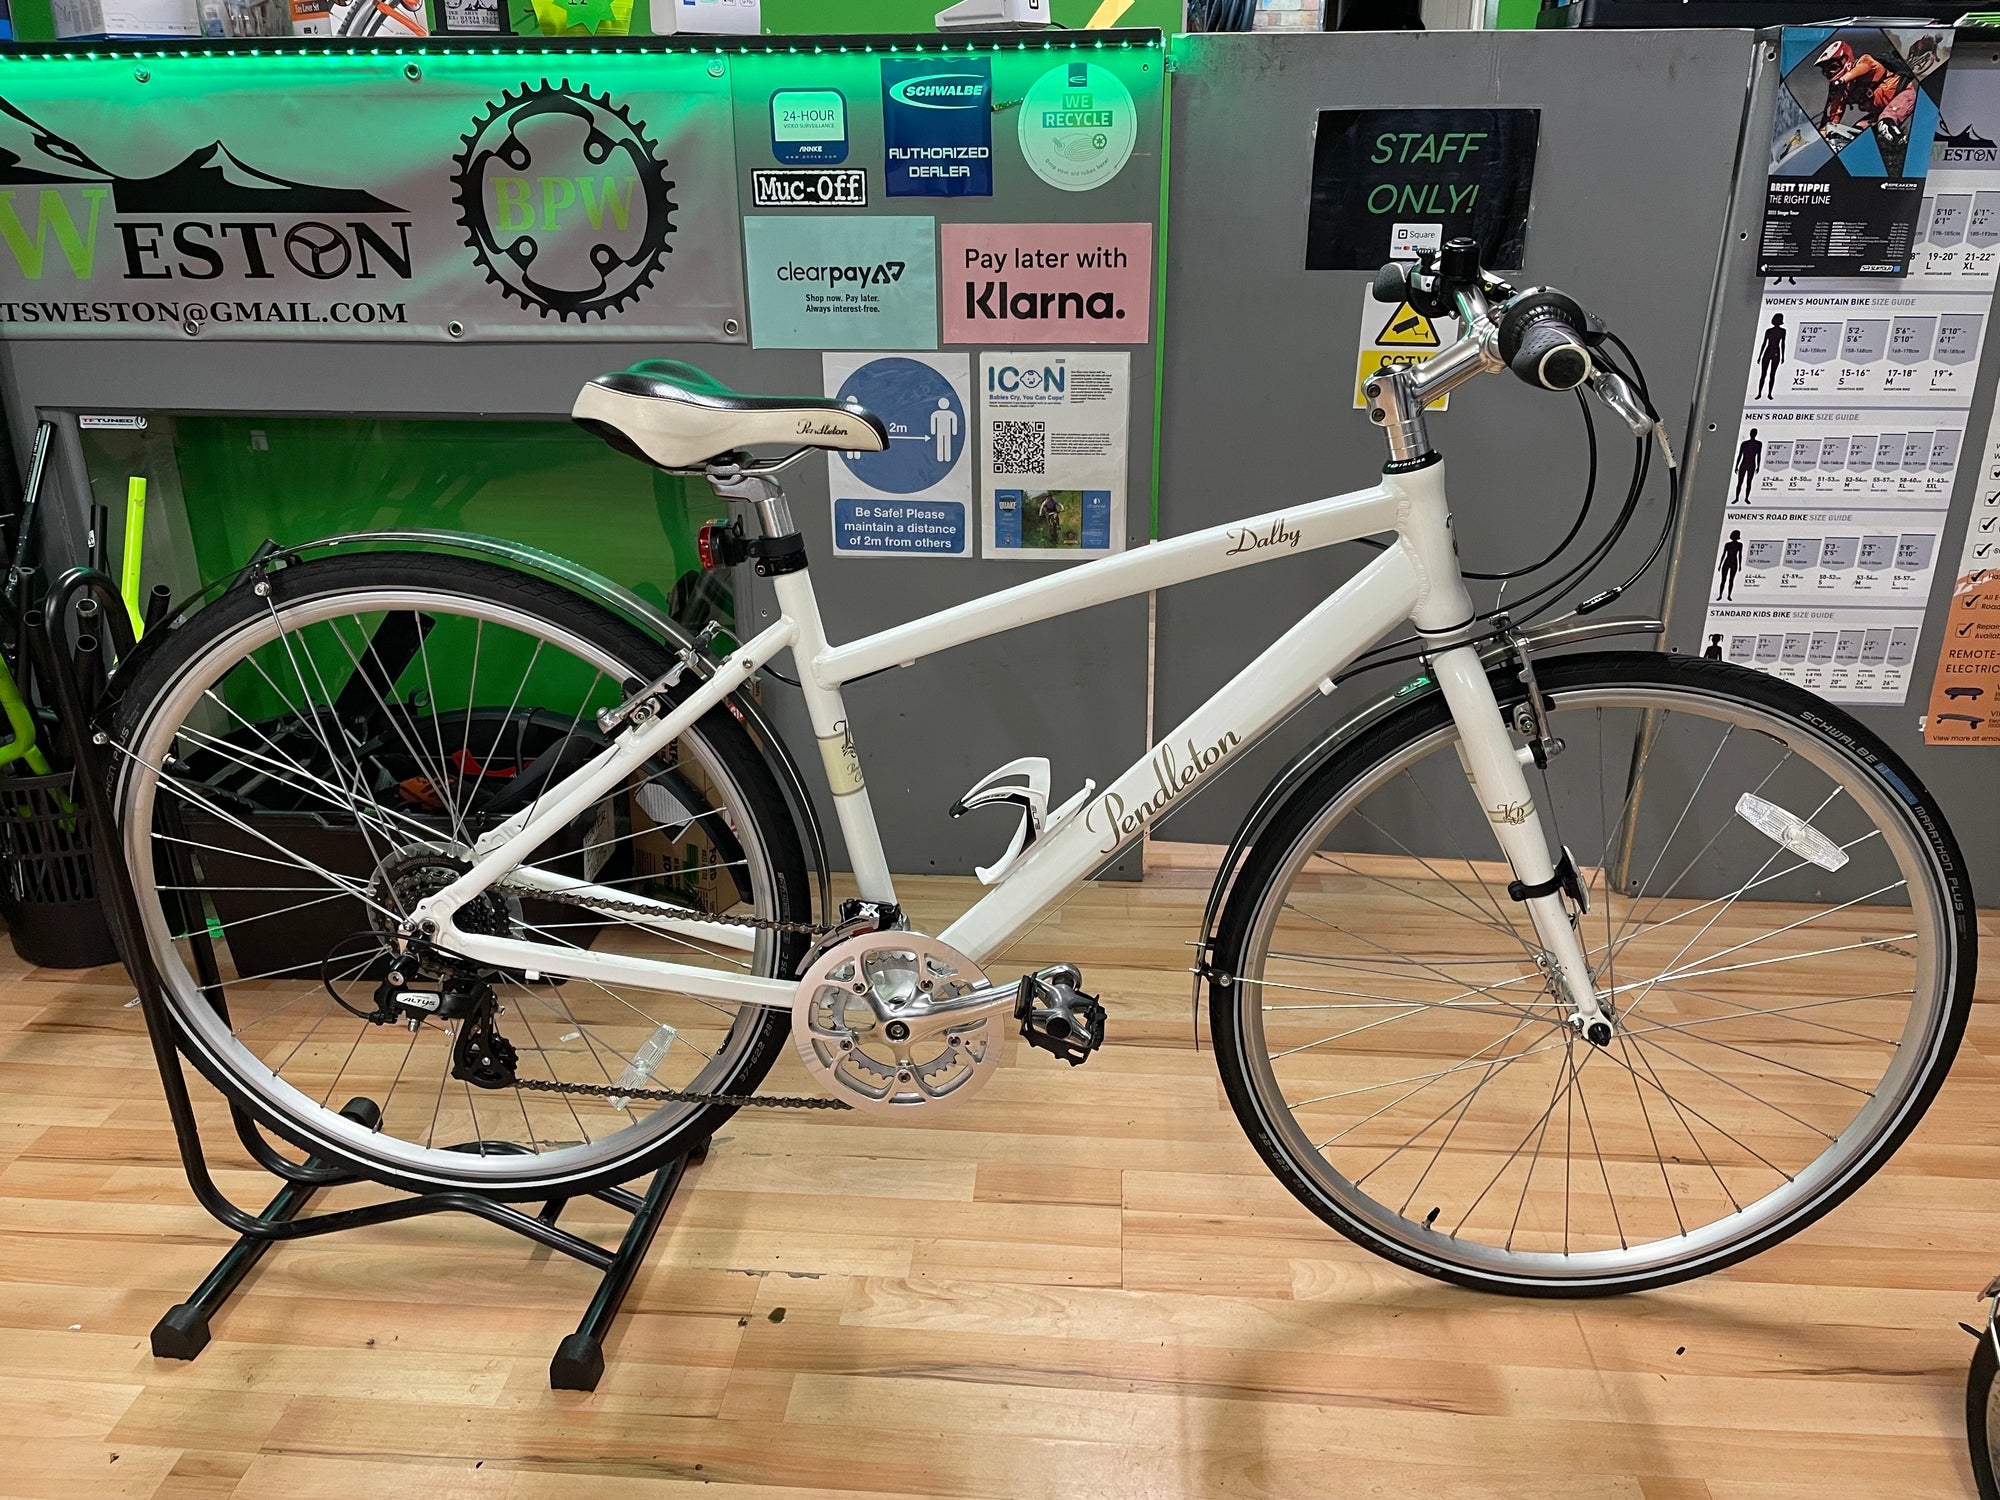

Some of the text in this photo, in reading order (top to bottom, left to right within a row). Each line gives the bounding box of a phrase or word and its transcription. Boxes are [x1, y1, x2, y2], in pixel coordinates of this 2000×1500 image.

[906, 85, 983, 96] SCHWALBE
[1065, 95, 1089, 108] WE
[783, 110, 835, 121] 24-HOUR
[1046, 112, 1109, 126] RECYCLE
[889, 147, 989, 159] AUTHORIZED
[1371, 133, 1487, 164] STAFF
[909, 165, 970, 177] DEALER
[759, 174, 860, 201] Muc-Off
[1770, 183, 1830, 193] BRETT TIPPIE
[491, 177, 637, 234] BPW
[1367, 184, 1480, 214] ONLY!
[1769, 194, 1831, 205] THE RIGHT LINE
[1409, 230, 1436, 239] Square
[965, 246, 1127, 273] Pay later with
[1926, 262, 1931, 270] L
[1963, 262, 1975, 270] XL
[777, 261, 871, 289] clearpay
[805, 294, 824, 303] Shop
[845, 294, 859, 303] Pay
[861, 294, 880, 302] later.
[966, 281, 1126, 320] Klarna.
[1765, 298, 1917, 306] WOMEN'S MOUNTAIN BIKE SIZE GUIDE
[0, 302, 408, 326] TSWESTON@GMAIL.COM
[805, 304, 880, 314] Always interest-free.
[1931, 378, 1937, 386] L
[1745, 413, 1860, 421] MEN'S ROAD BIKE SIZE GUIDE
[796, 418, 848, 436] Pendleton
[889, 422, 908, 433] 2m
[855, 507, 945, 520] Be Safe! Please
[1727, 513, 1764, 521] WOMEN'S
[1765, 513, 1788, 521] ROAD
[1789, 513, 1808, 521] BIKE
[844, 521, 957, 534] maintain a distance
[849, 535, 952, 549] of 2m from others
[1225, 518, 1302, 556] Dalby
[1949, 649, 2000, 659] REMOTE-
[1800, 710, 1880, 765] SCHWALBE
[1085, 730, 1242, 853] Pendleton
[1914, 805, 1954, 871] MARATHON
[1948, 876, 1964, 911] PLUS
[738, 1042, 766, 1083] 37-622
